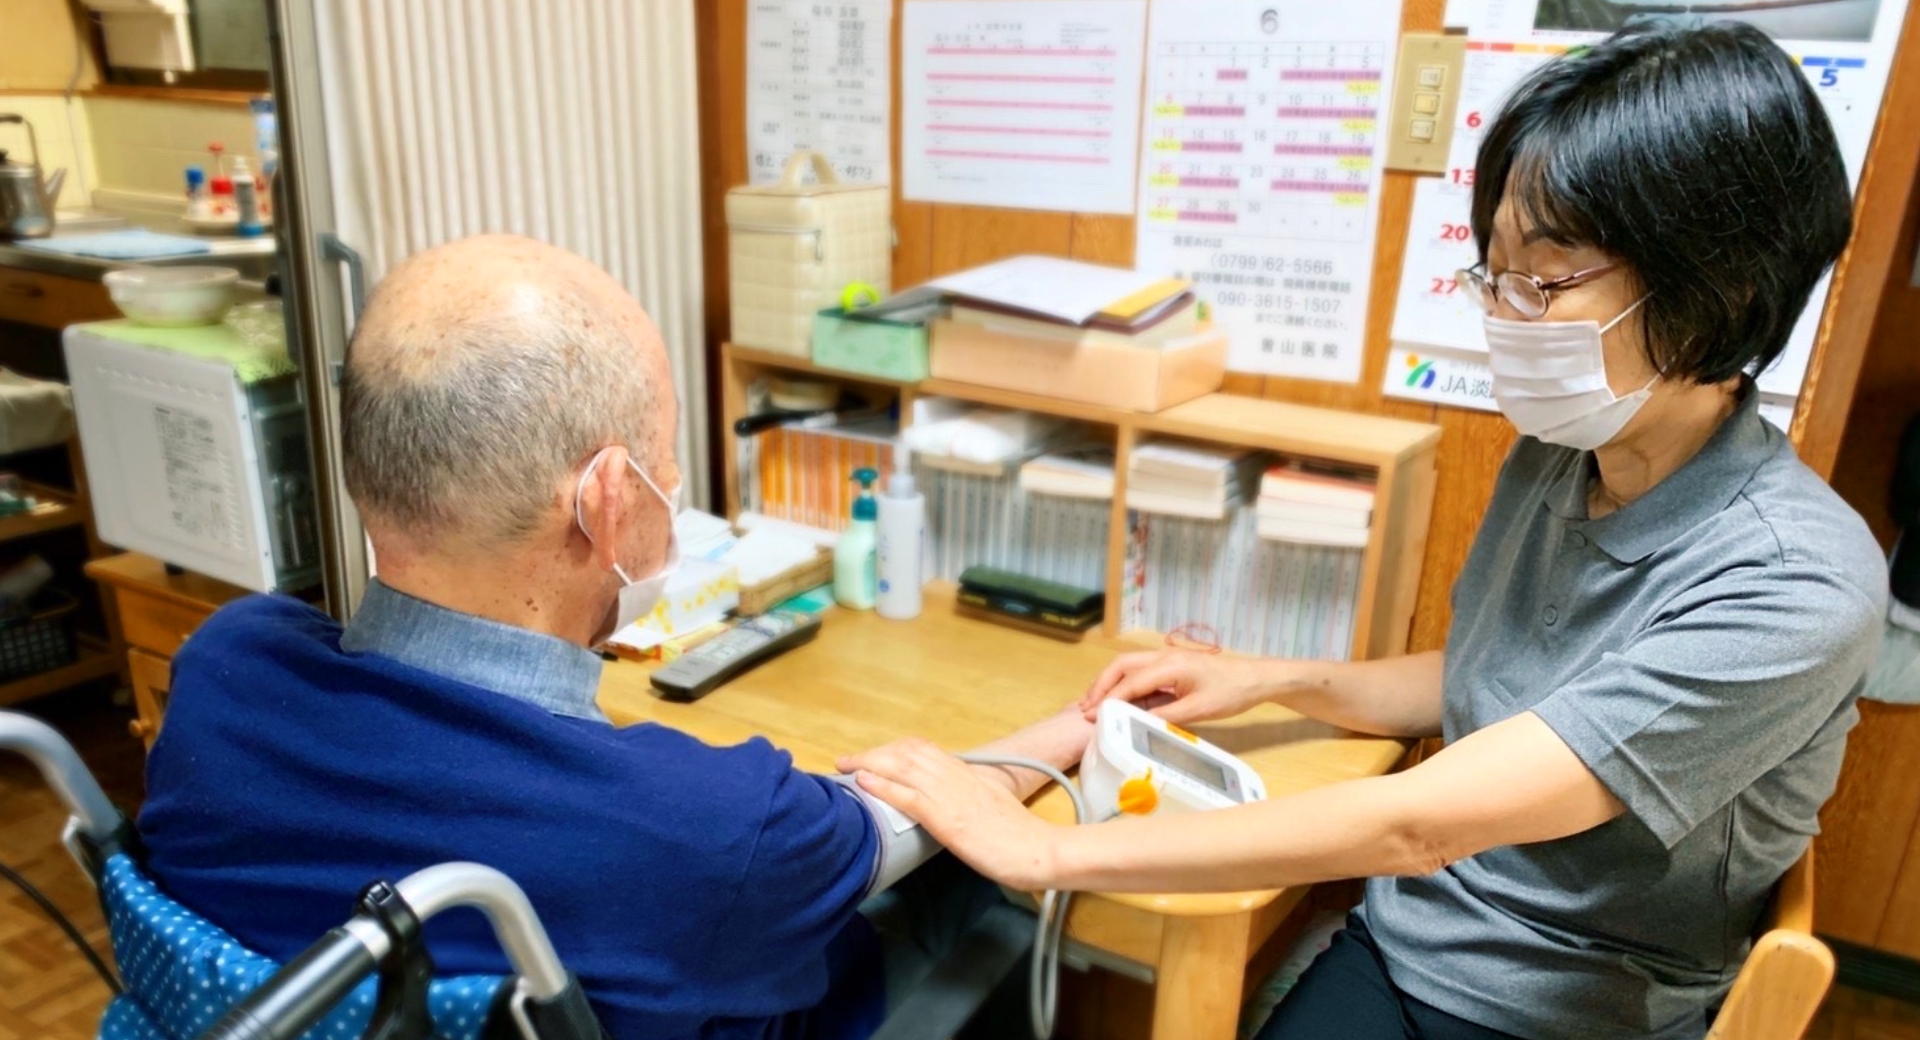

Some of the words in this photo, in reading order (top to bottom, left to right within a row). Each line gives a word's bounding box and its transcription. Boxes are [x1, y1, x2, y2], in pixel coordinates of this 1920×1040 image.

[1260, 9, 1279, 34] 6
[1819, 68, 1838, 87] 5
[1466, 112, 1482, 128] 6
[1451, 168, 1477, 187] 13
[1439, 223, 1470, 241] 20
[1430, 278, 1459, 295] 27
[1217, 291, 1342, 315] 090-3615-1507
[1440, 374, 1496, 400] JA淡
